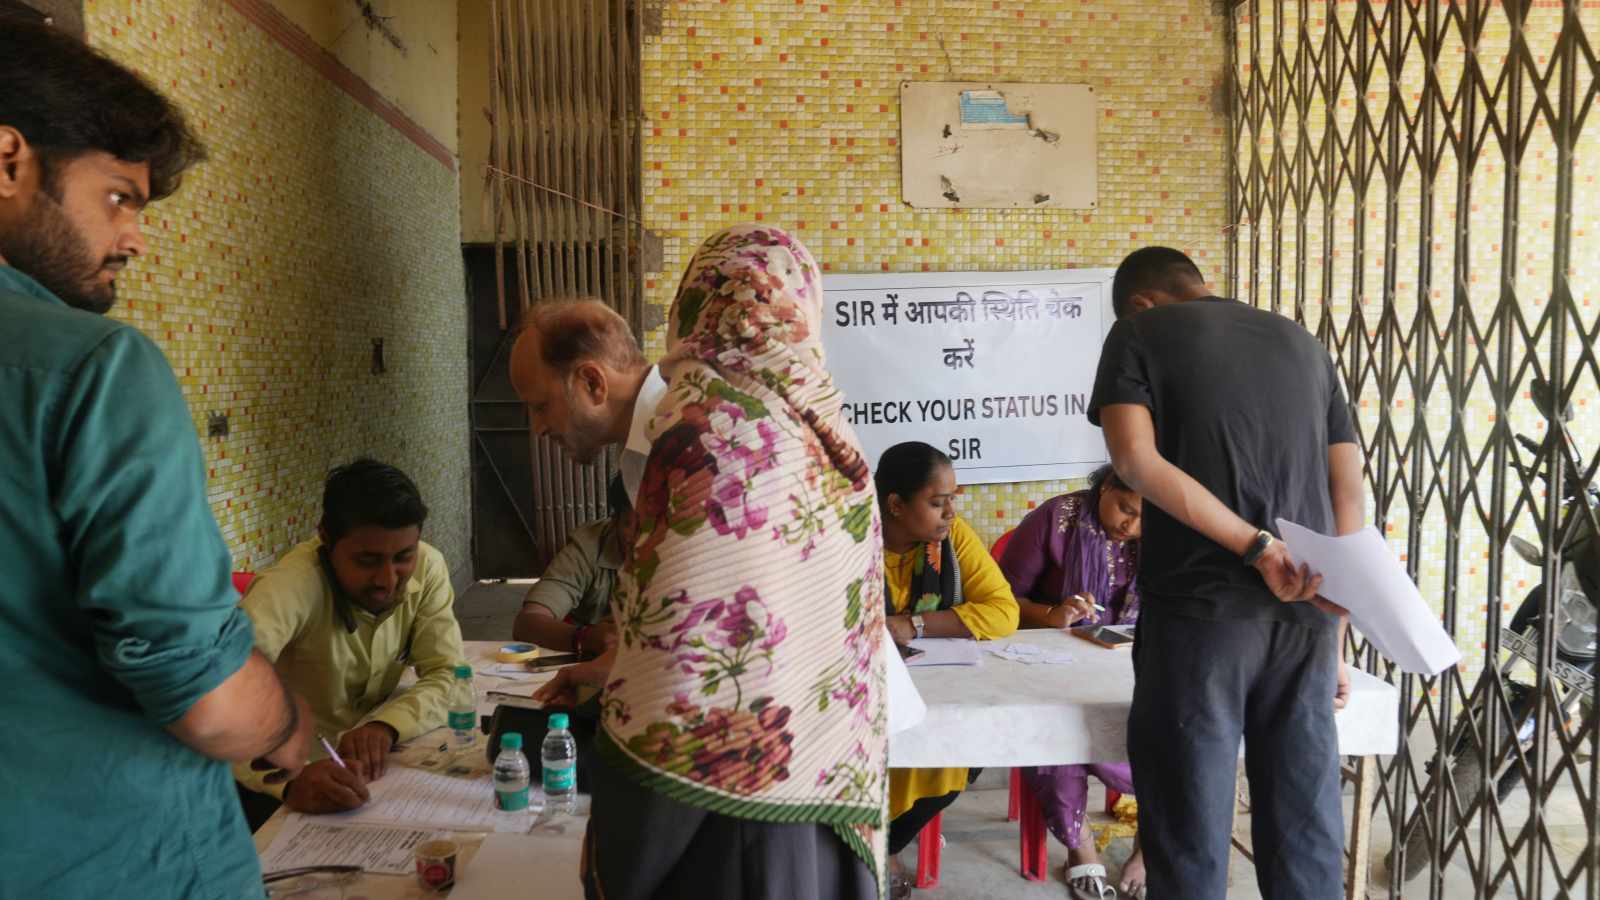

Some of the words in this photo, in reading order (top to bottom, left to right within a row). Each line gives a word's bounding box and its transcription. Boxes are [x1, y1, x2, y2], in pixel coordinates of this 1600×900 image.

[836, 301, 876, 327] SIR
[881, 294, 899, 326] में
[904, 291, 977, 325] आपकी
[981, 290, 1041, 322] स्थिति
[1044, 288, 1083, 320] चेक
[942, 338, 976, 370] करें
[840, 401, 912, 424] CHECK
[917, 398, 977, 422] YOUR
[981, 395, 1058, 418] STATUS
[1063, 394, 1086, 416] IN
[948, 438, 982, 460] SIR
